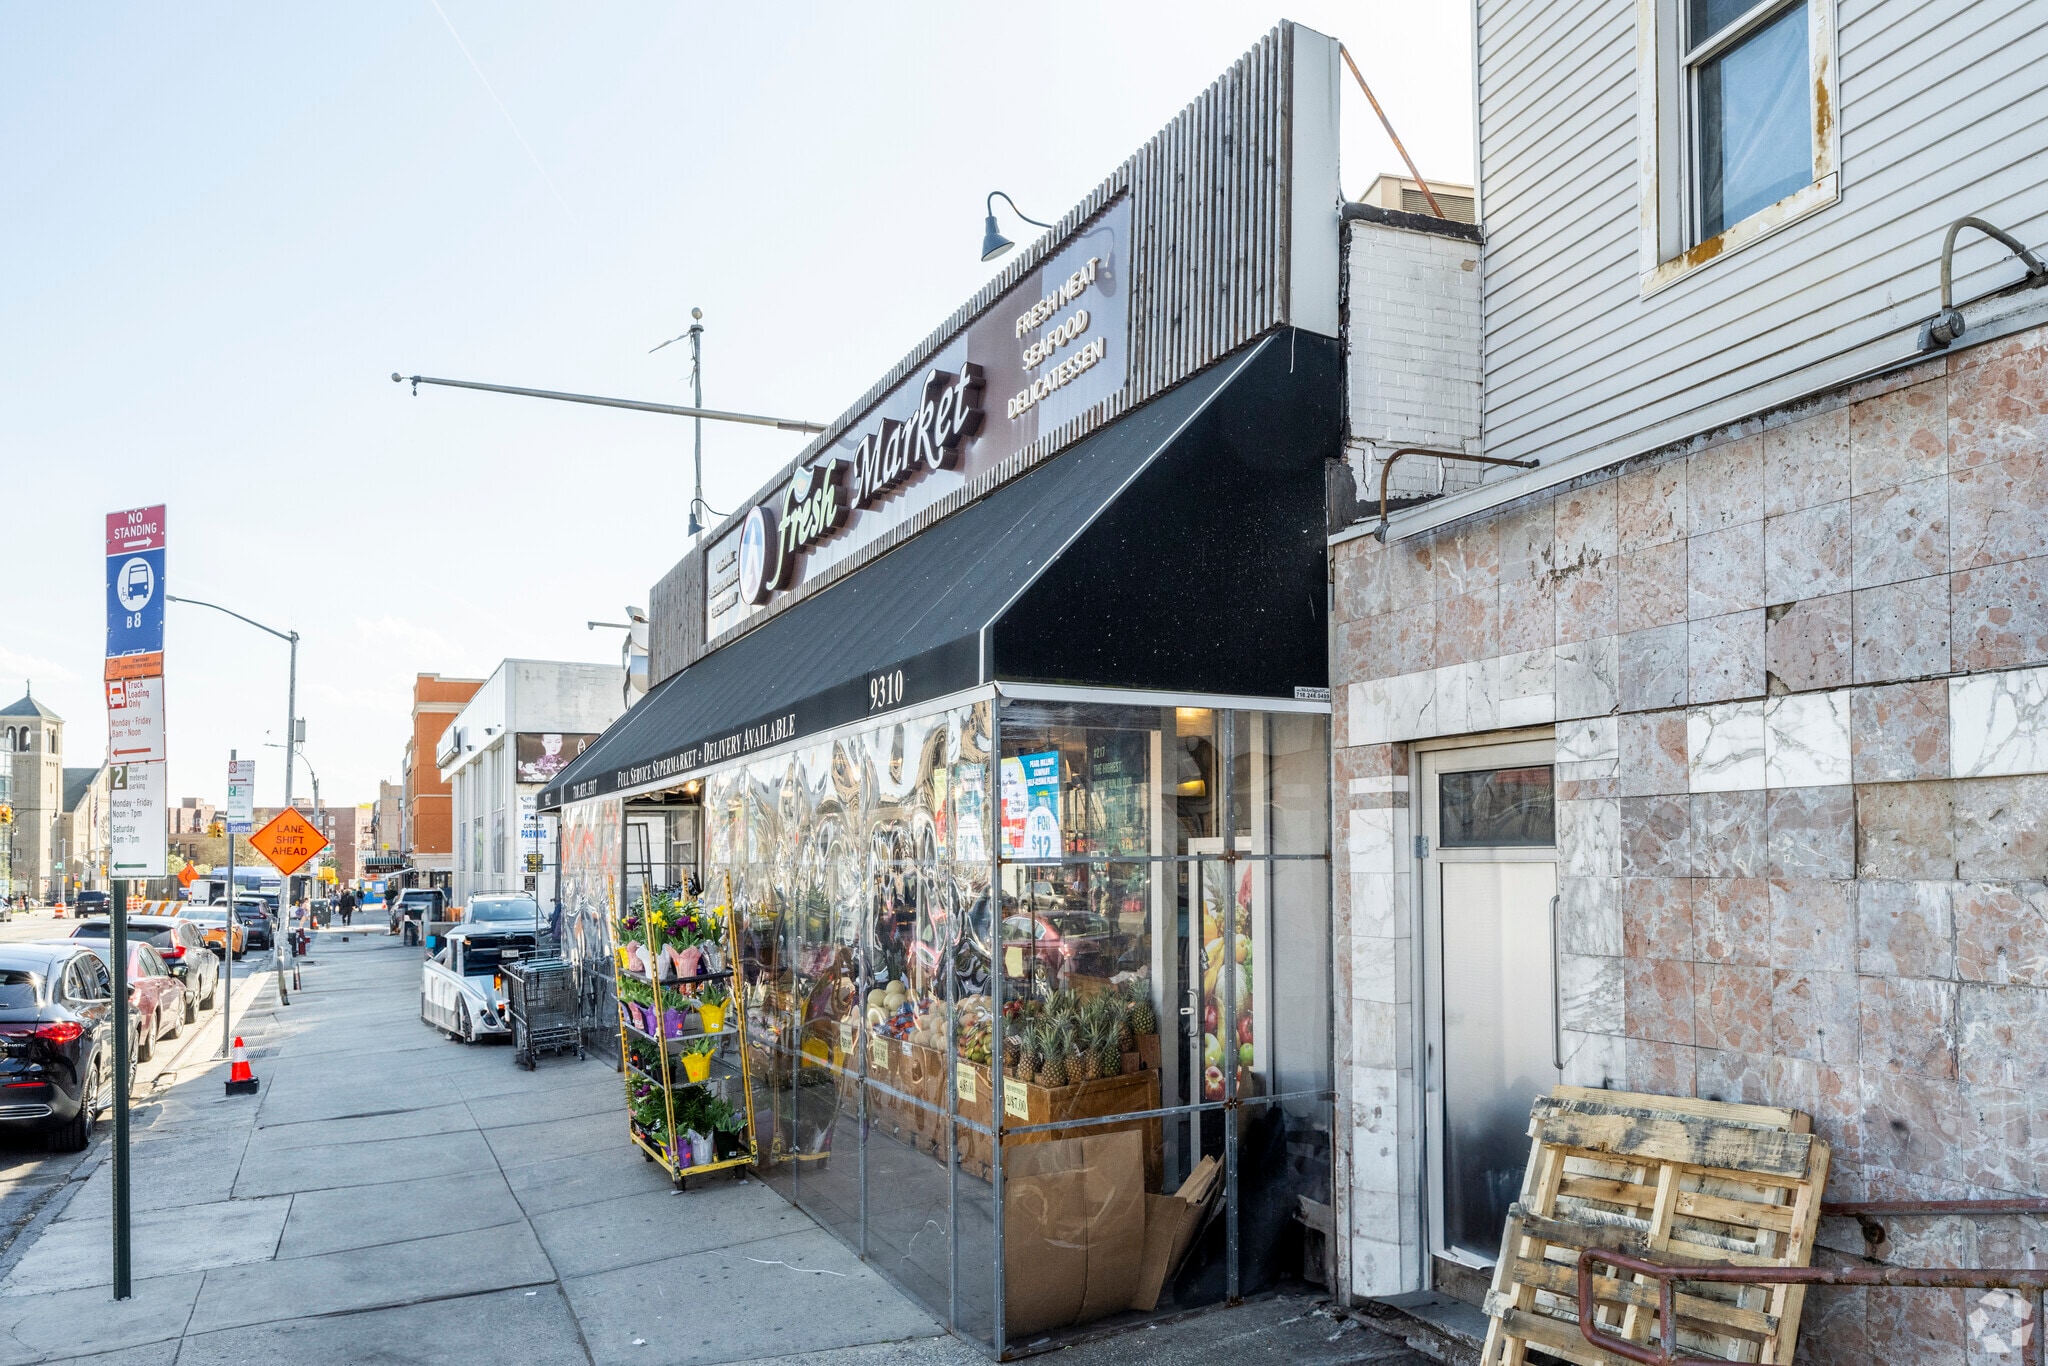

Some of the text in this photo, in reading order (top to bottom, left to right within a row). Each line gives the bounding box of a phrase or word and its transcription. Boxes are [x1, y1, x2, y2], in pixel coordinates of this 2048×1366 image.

[1016, 256, 1100, 339] FRESH MEAT
[1022, 309, 1089, 371] SEAFOOD
[1007, 337, 1105, 419] DELICATESSEN
[851, 361, 973, 510] Market
[128, 512, 143, 524] NO
[114, 522, 158, 540] STANDING
[128, 681, 143, 690] Truck
[870, 669, 903, 710] 9310
[128, 689, 150, 699] Loading
[128, 699, 141, 708] Only
[111, 718, 131, 729] Monday
[135, 716, 152, 726] Friday
[112, 729, 123, 738] 8am
[127, 728, 141, 737] Noon
[617, 713, 796, 788] FULL SERVICE SUPERMARKET DELIVERY AVAILABLE
[1093, 761, 1122, 776] THE HIGHEST
[114, 765, 139, 789] 2 hour
[129, 782, 146, 791] parking
[229, 786, 235, 796] 2
[112, 799, 132, 808] Monday
[136, 797, 153, 808] Friday
[112, 810, 126, 818] Noon
[130, 809, 142, 819] 7pm
[112, 823, 136, 834] Saturday
[1037, 815, 1051, 831] FOR
[277, 824, 304, 834] LANE
[521, 829, 547, 838] PARKNG
[112, 835, 124, 844] 8am
[128, 834, 140, 845] 7pm
[276, 836, 304, 845] SHIFT
[271, 846, 308, 856] AHEAD
